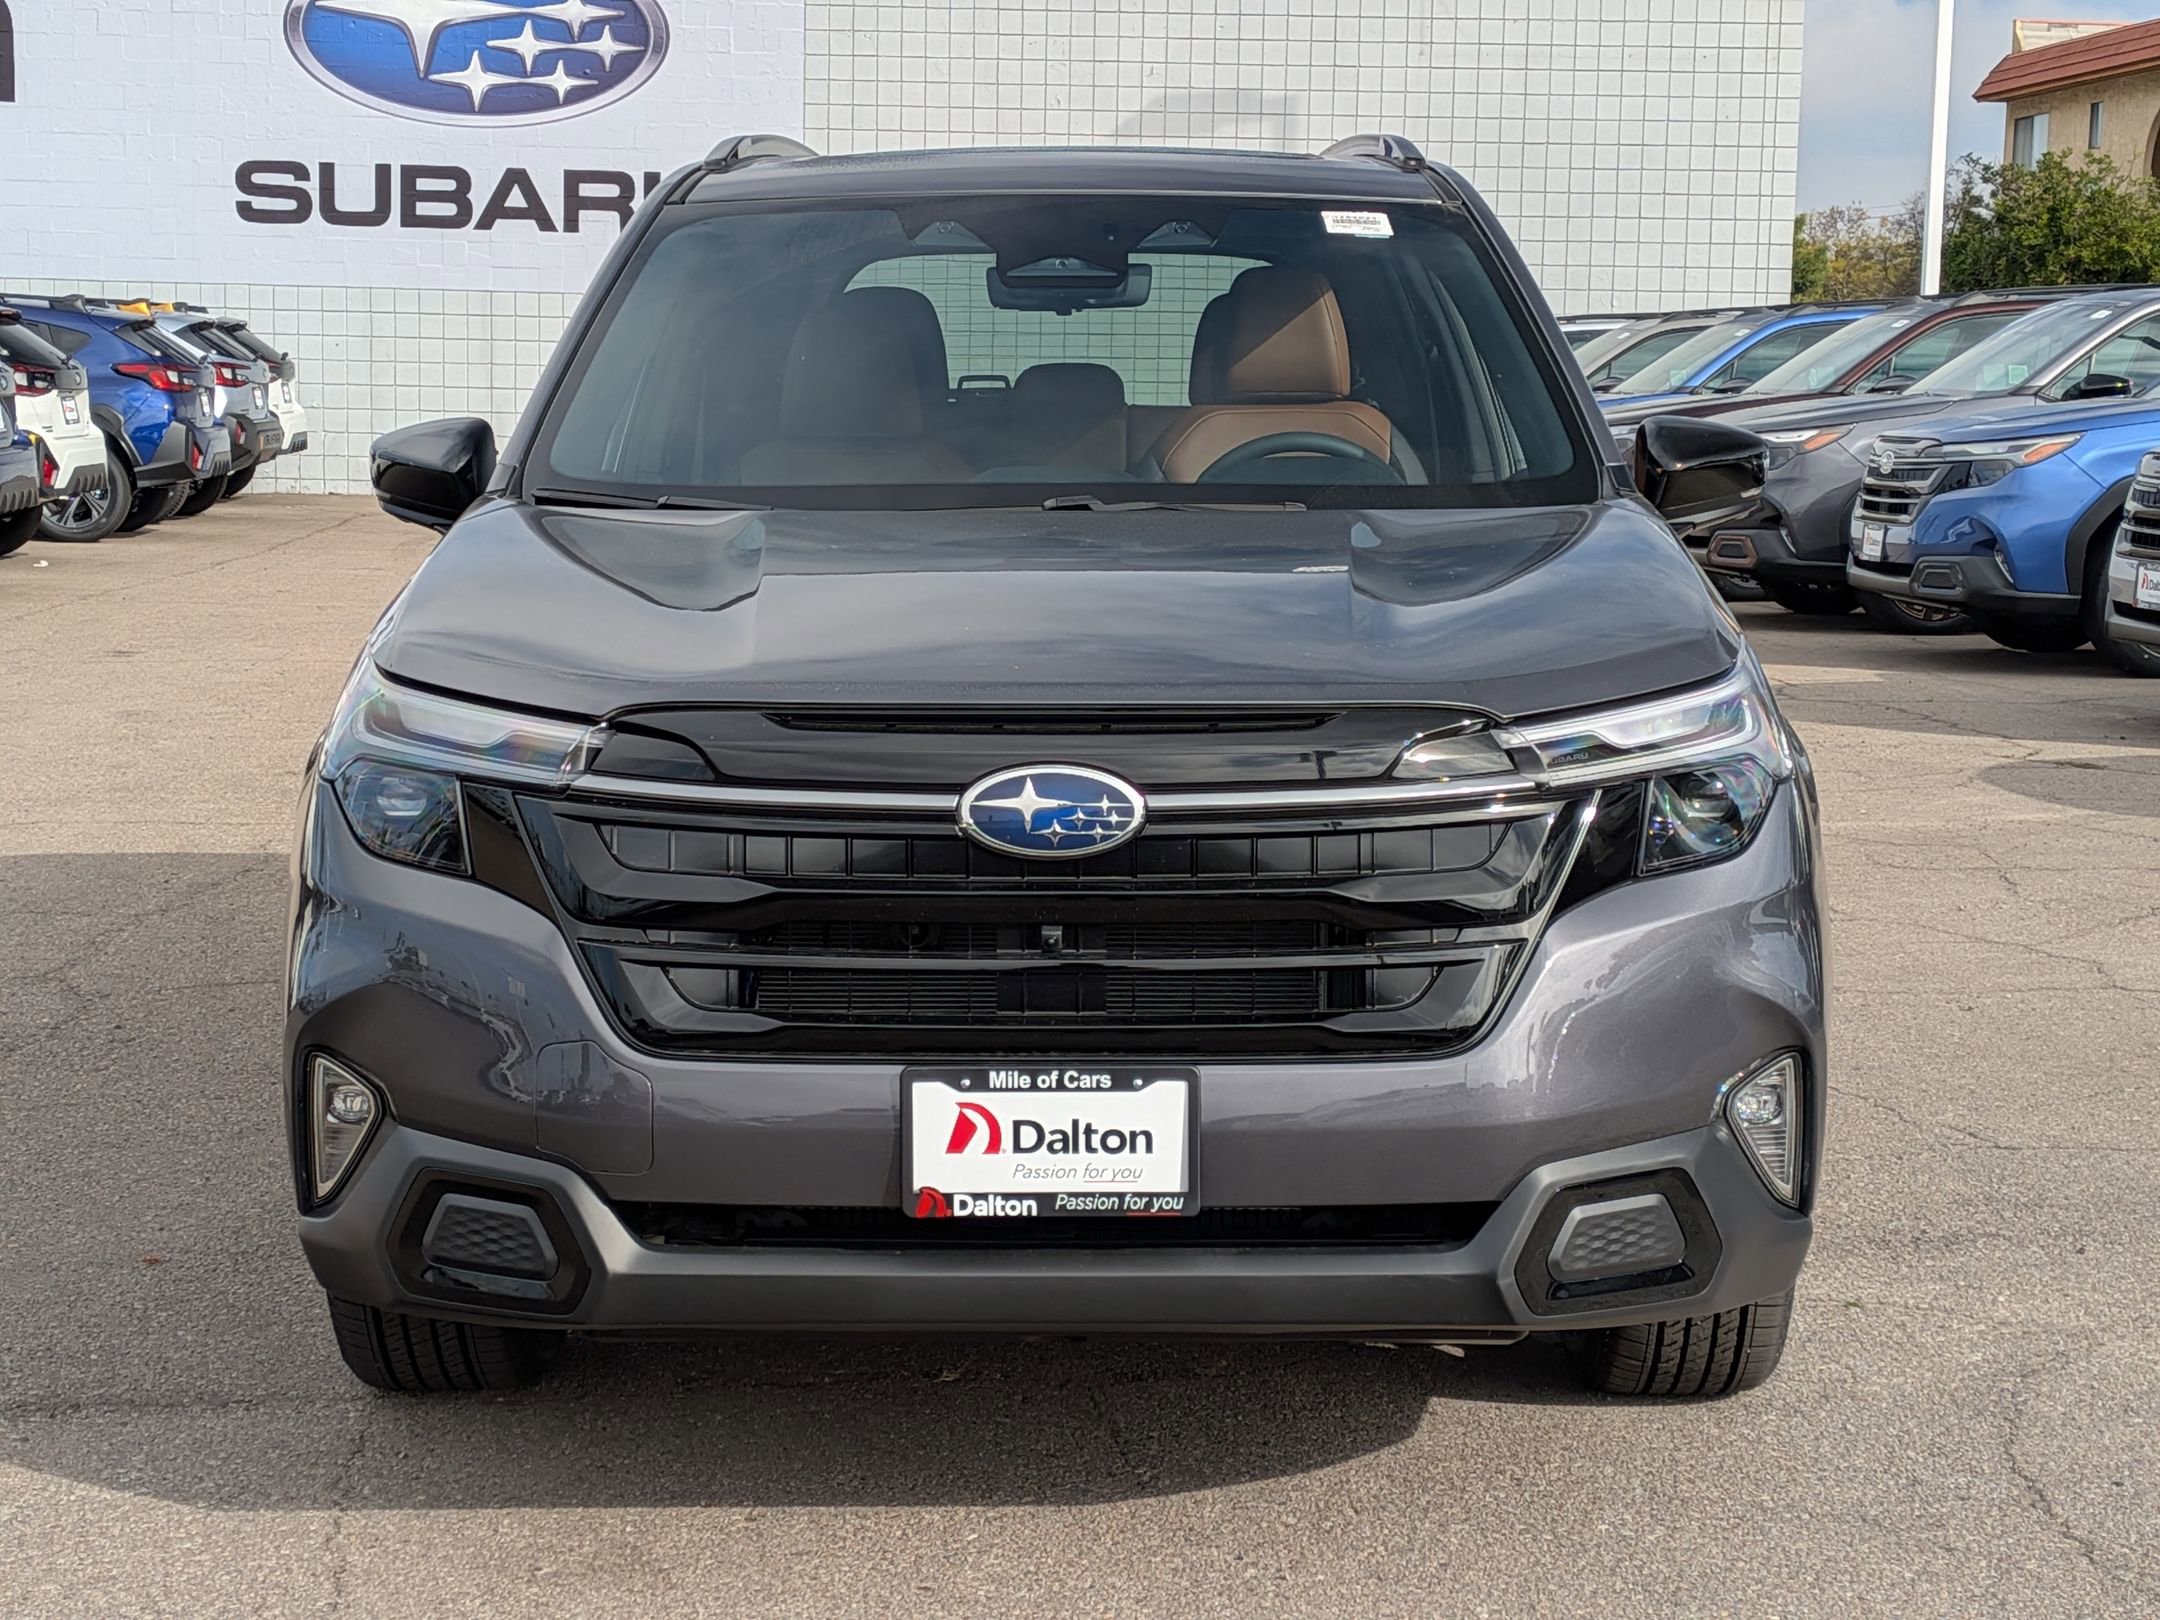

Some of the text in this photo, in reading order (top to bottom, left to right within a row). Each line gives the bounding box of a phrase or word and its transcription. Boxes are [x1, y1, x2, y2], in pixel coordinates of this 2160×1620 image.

[235, 160, 662, 233] SUBAR
[988, 1070, 1112, 1089] Mile of Cars
[1012, 1118, 1153, 1155] Dalton
[1012, 1162, 1144, 1182] Passion for you
[952, 1193, 1038, 1217] Dalton
[1054, 1193, 1184, 1213] Passion for you
